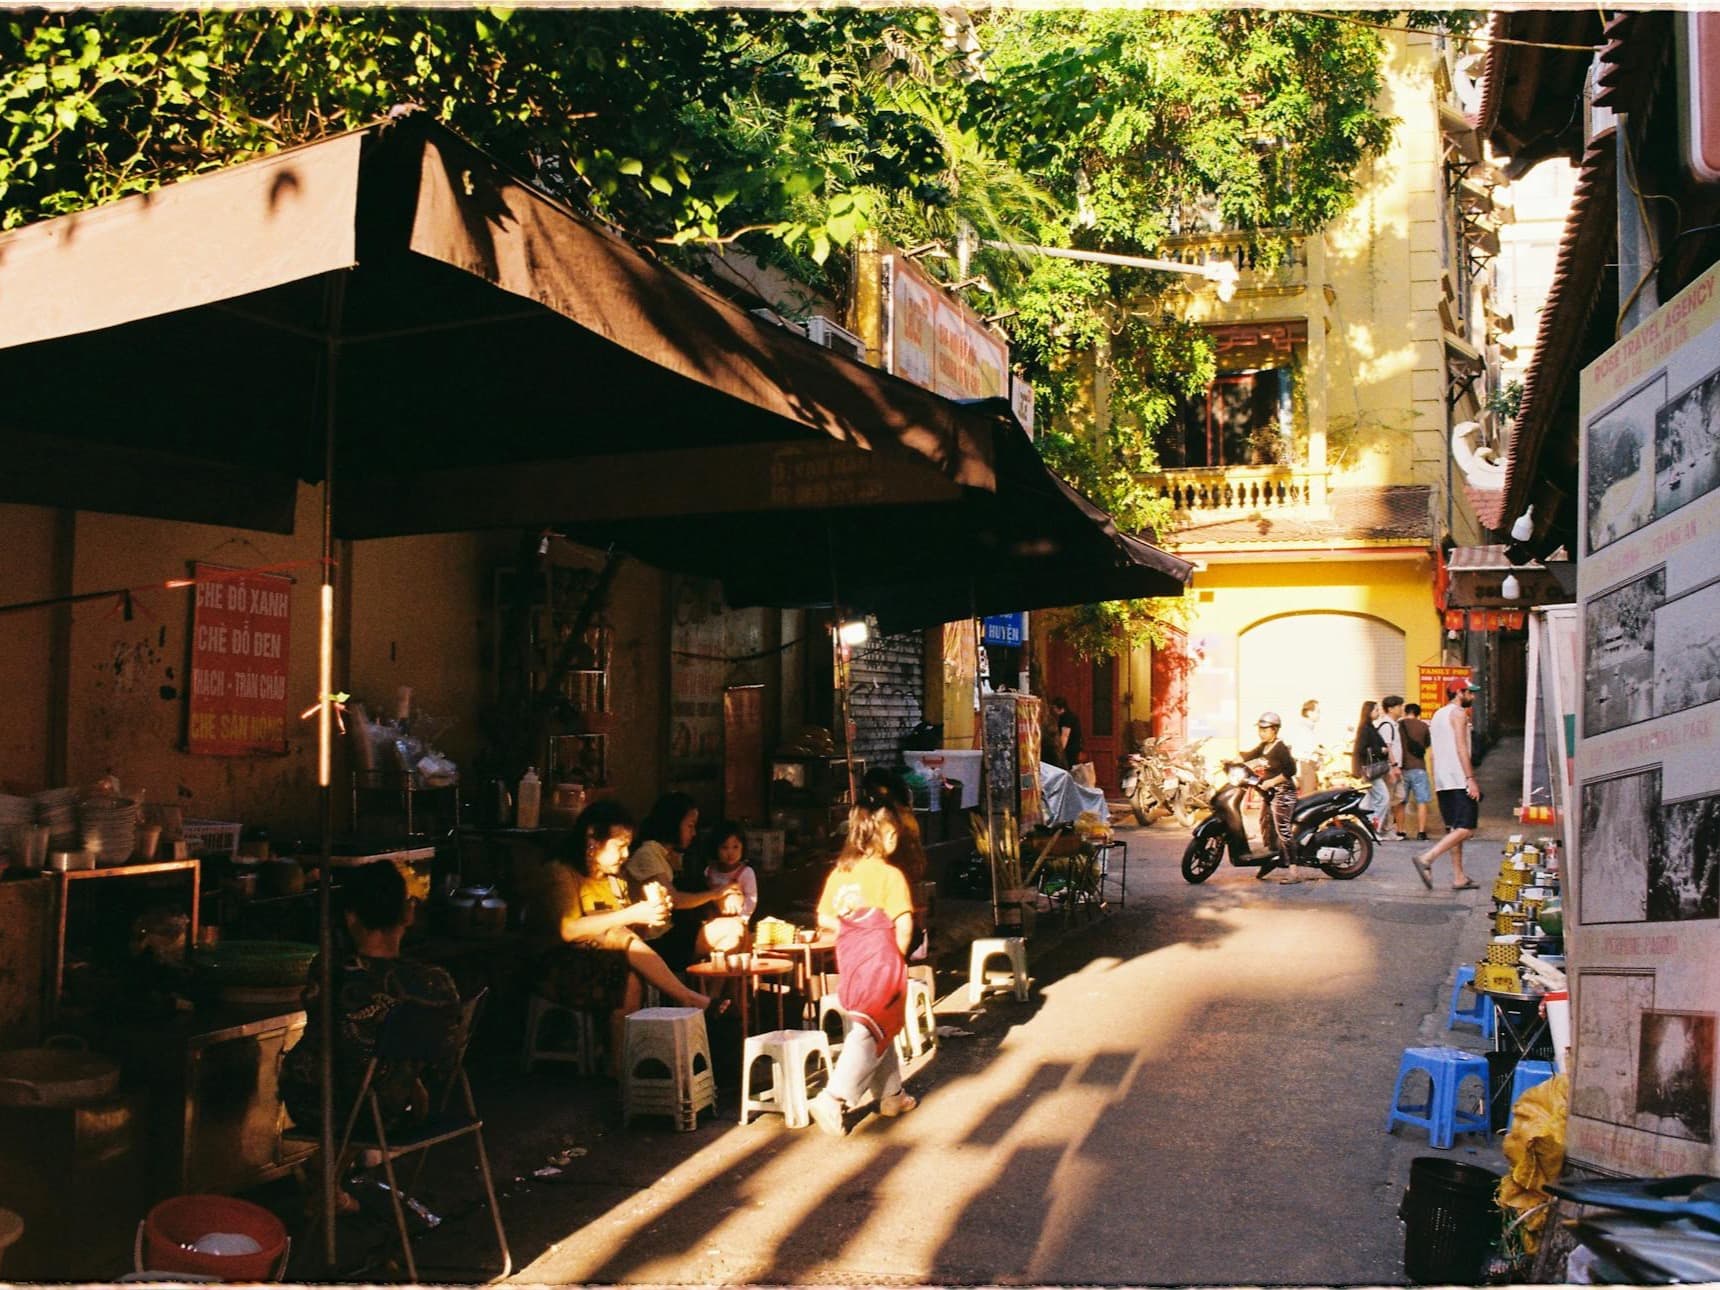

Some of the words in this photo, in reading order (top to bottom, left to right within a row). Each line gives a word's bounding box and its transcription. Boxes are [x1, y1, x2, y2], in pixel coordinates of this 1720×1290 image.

[1593, 351, 1619, 382] ROSE
[1623, 319, 1659, 359] TRAVEL
[1664, 275, 1715, 329] AGENCY
[250, 588, 288, 617] XANH
